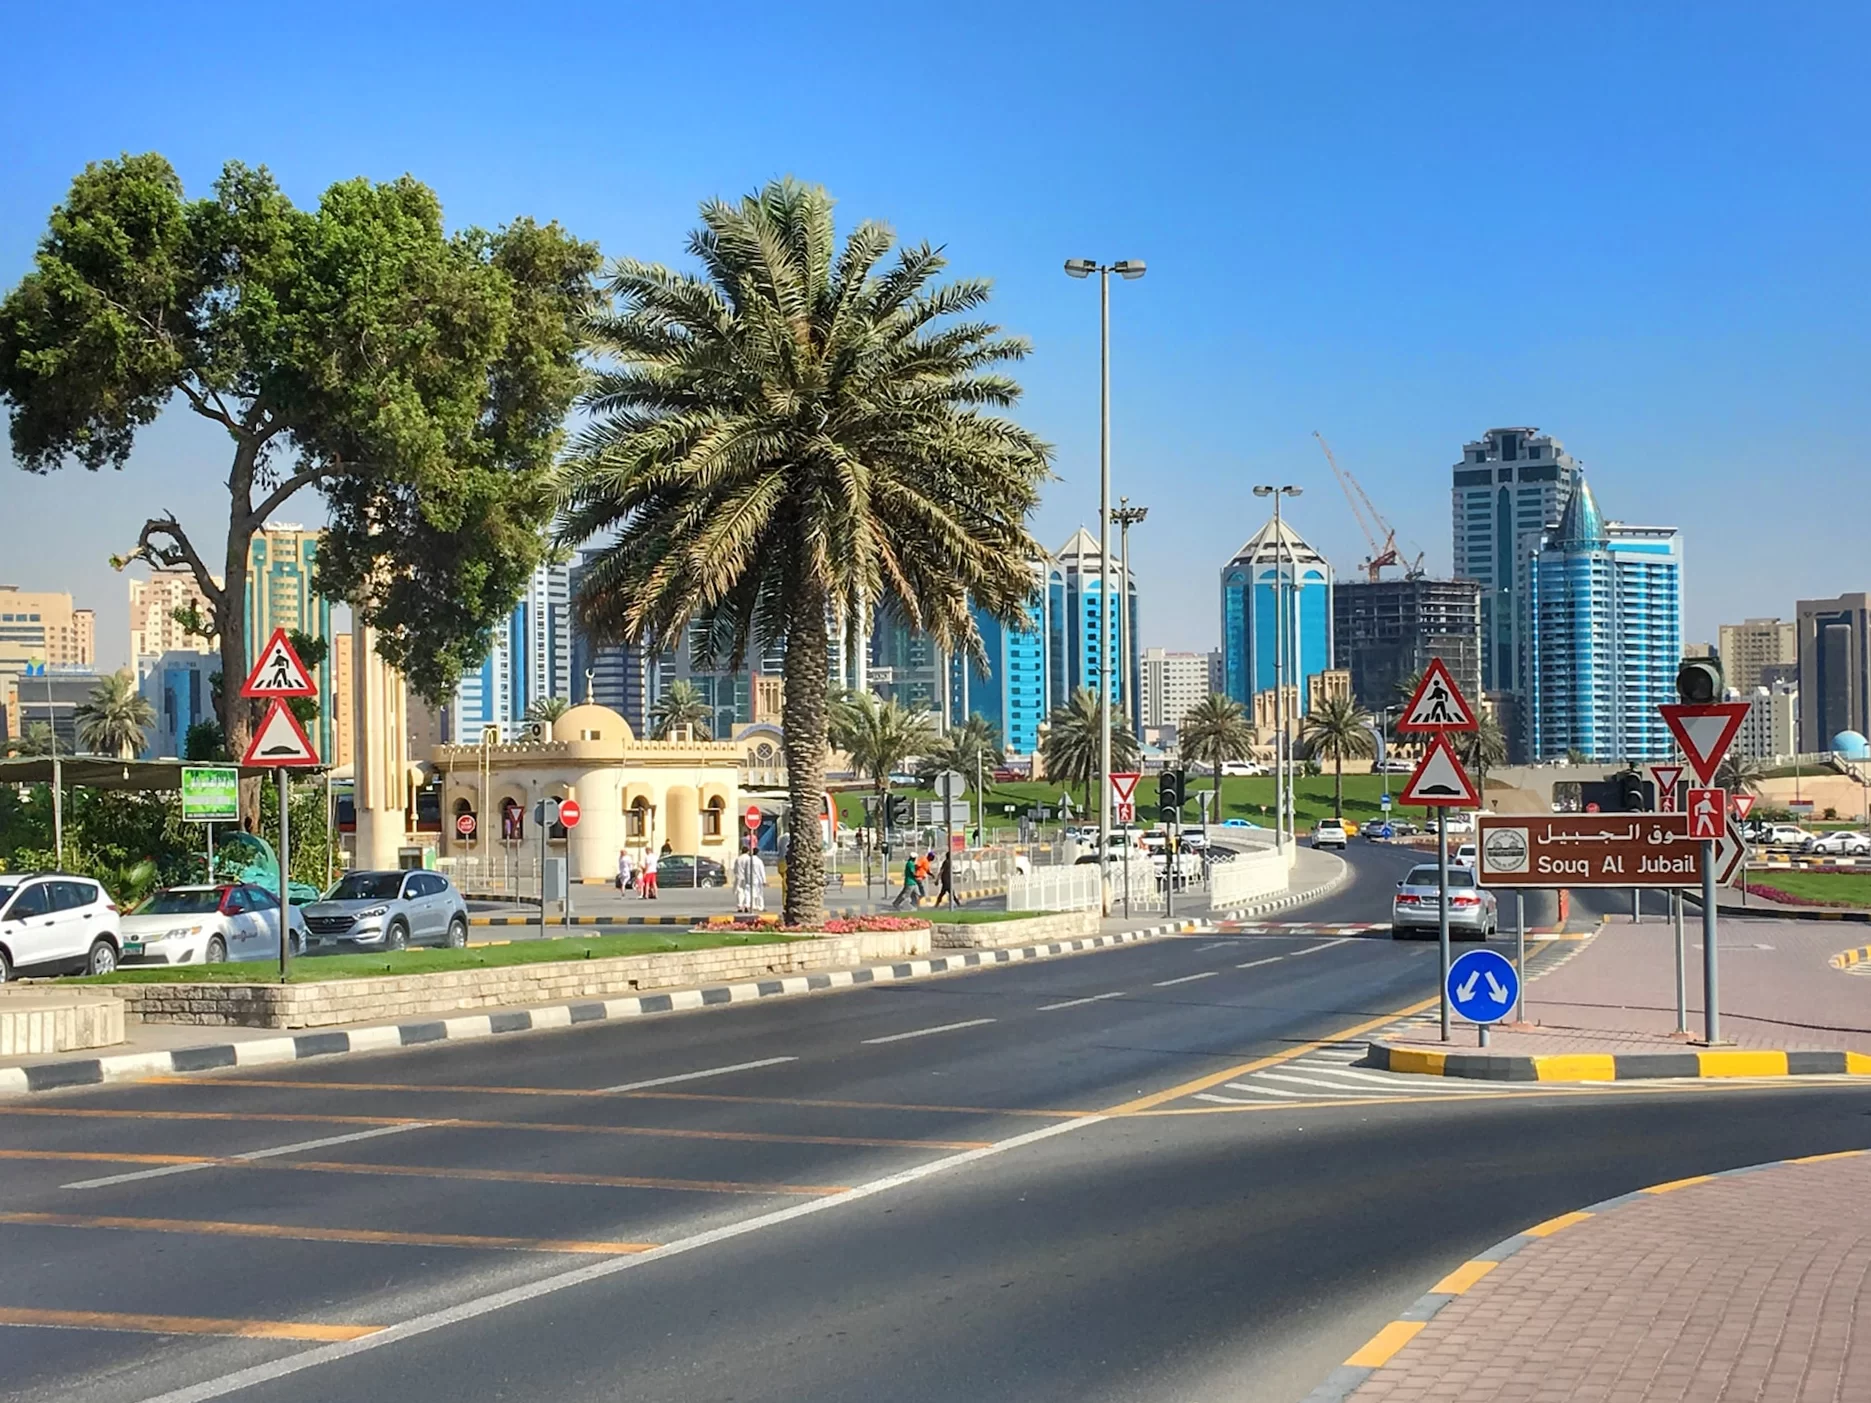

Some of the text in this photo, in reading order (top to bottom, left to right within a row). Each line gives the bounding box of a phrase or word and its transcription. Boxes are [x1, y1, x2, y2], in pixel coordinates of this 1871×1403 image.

[1538, 823, 1688, 845] وق الجبيل
[1537, 856, 1590, 877] Souq
[1602, 856, 1625, 873] Al
[1637, 855, 1697, 873] Jubail
